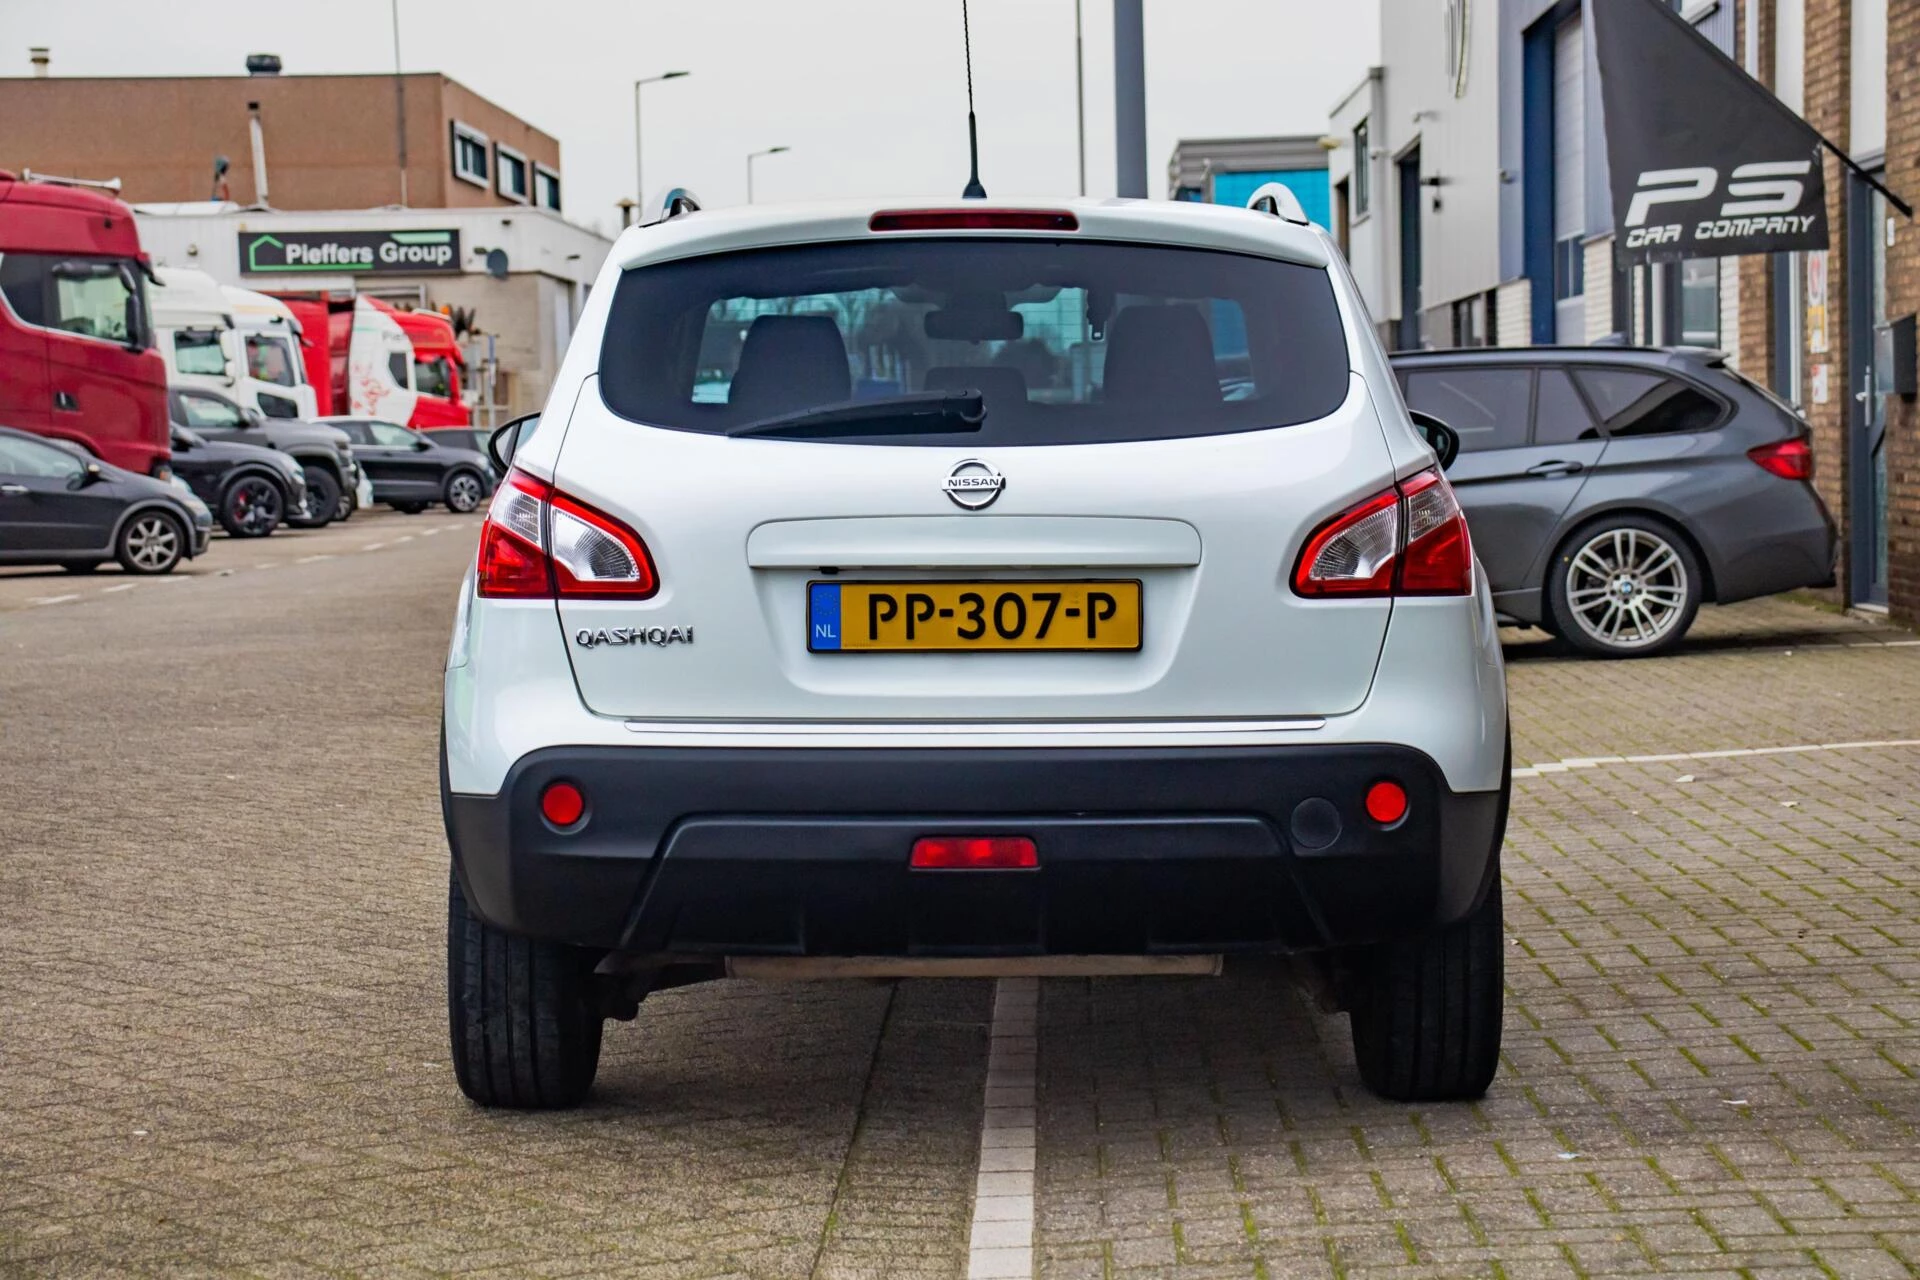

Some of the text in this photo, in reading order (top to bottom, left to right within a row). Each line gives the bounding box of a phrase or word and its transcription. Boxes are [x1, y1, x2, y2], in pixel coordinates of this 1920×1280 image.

[1624, 160, 1812, 227] PS
[1626, 215, 1816, 248] CAR COMPANY
[285, 241, 453, 266] Pieffers Group
[948, 478, 999, 487] NISSAN
[868, 592, 1117, 640] PP-307-P
[576, 625, 694, 648] QASHQAI
[815, 623, 837, 639] NL
